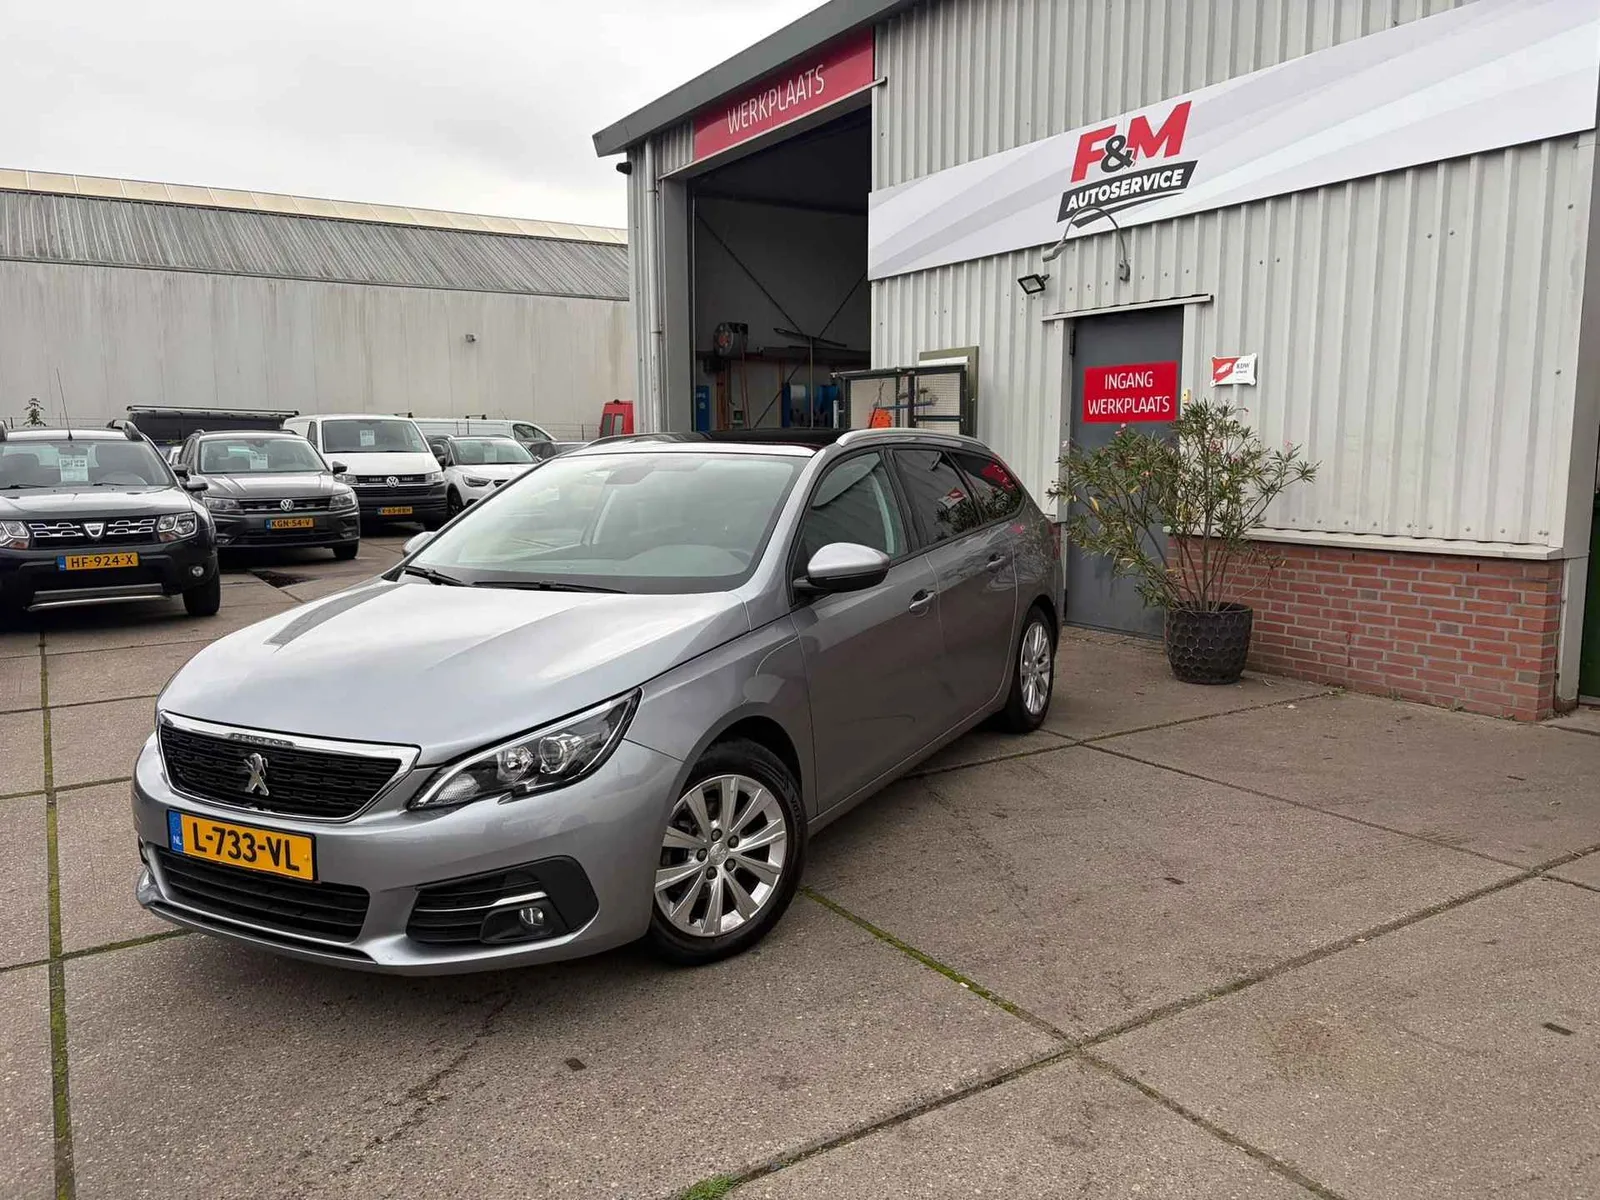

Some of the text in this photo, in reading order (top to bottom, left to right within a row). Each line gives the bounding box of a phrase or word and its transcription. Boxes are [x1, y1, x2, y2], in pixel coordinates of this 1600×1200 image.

[727, 64, 825, 134] WERKPLAATS
[1070, 100, 1192, 183] F&M
[1066, 168, 1185, 212] AUTOSERVICE
[1104, 371, 1153, 390] INGANG
[1088, 395, 1170, 415] WERKPLAATS
[71, 554, 134, 568] HF-924-X
[192, 822, 300, 872] L-733-VL
